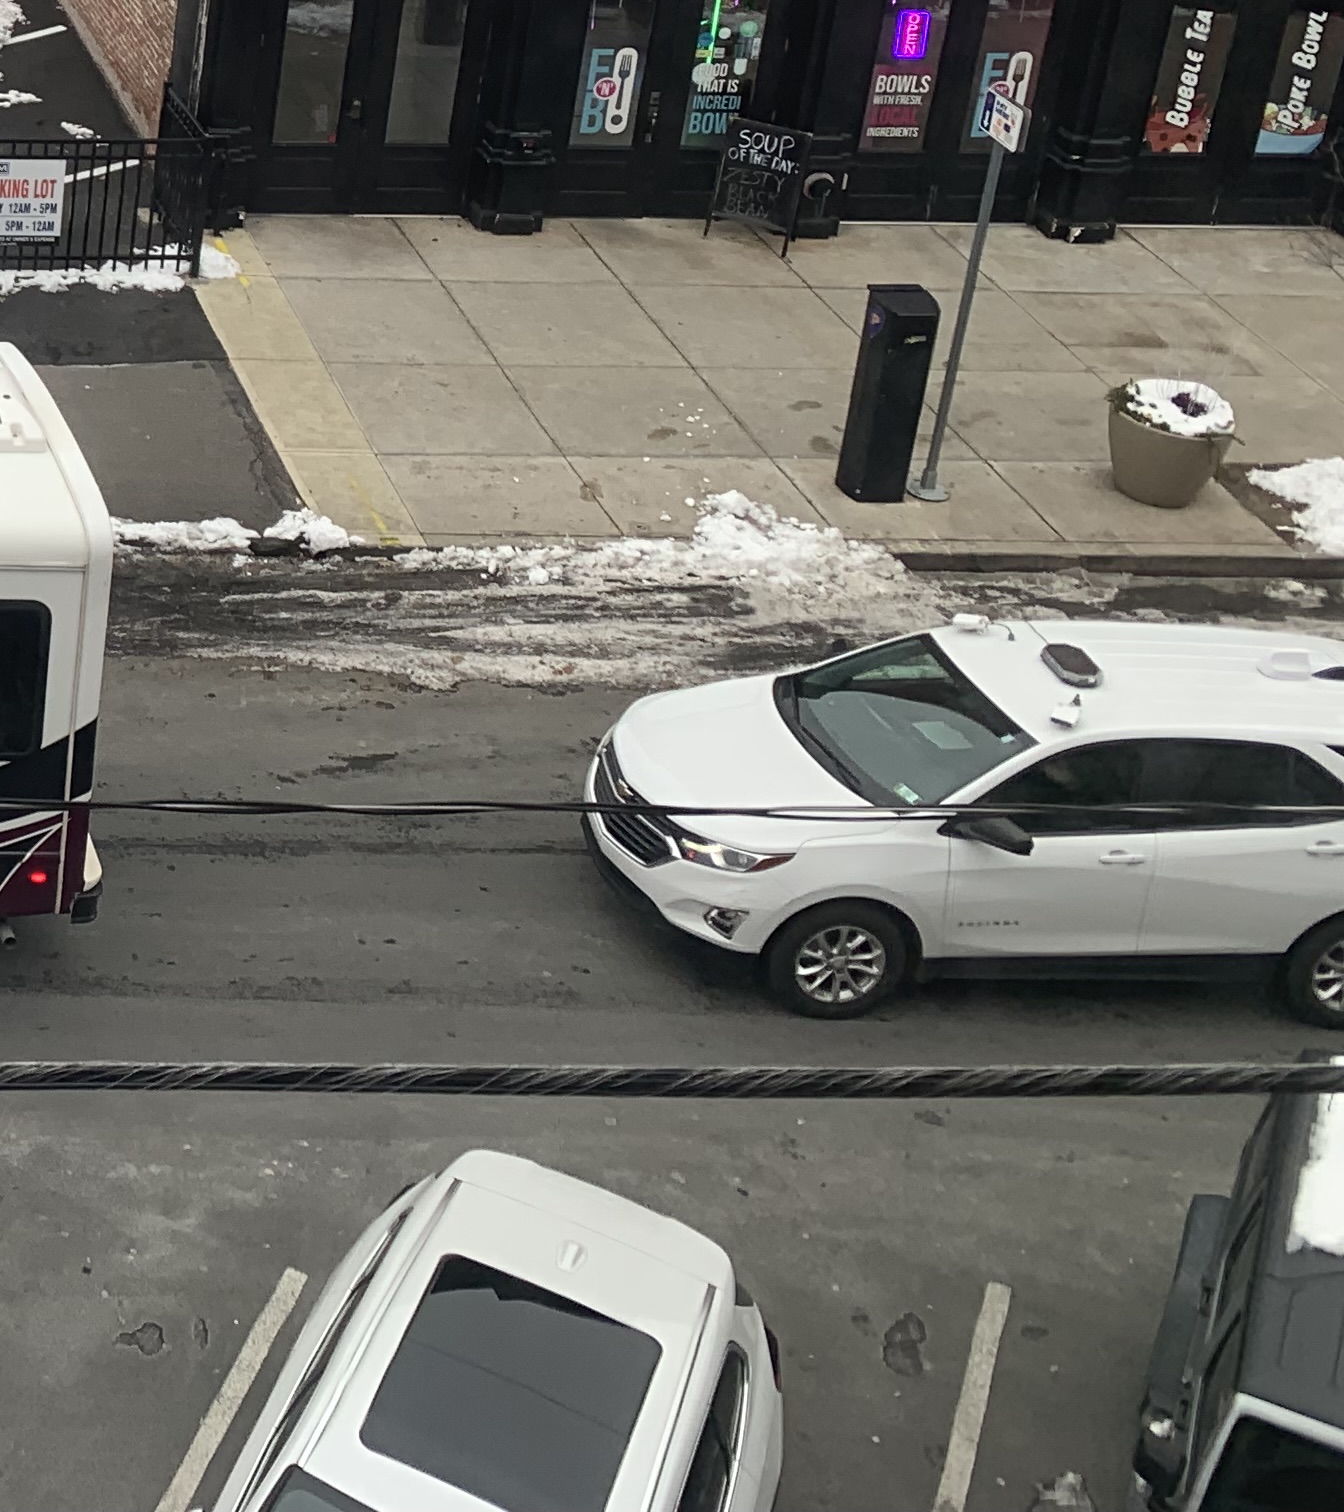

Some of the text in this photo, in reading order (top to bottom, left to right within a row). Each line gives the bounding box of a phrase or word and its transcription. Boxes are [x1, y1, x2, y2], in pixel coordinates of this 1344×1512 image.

[903, 13, 920, 55] OPEN
[727, 79, 740, 93] IS
[875, 75, 931, 94] BOWLS
[692, 95, 742, 110] INCREDI
[873, 94, 894, 105] WITH
[866, 127, 919, 138] INGREDIENTS
[739, 129, 795, 158] SOUP
[728, 147, 747, 162] OF
[749, 149, 772, 166] THE
[34, 179, 57, 199] LOT
[9, 203, 31, 214] 12AM
[40, 203, 58, 214] 5PM
[5, 221, 23, 231] 5PM
[32, 221, 54, 232] 12AM
